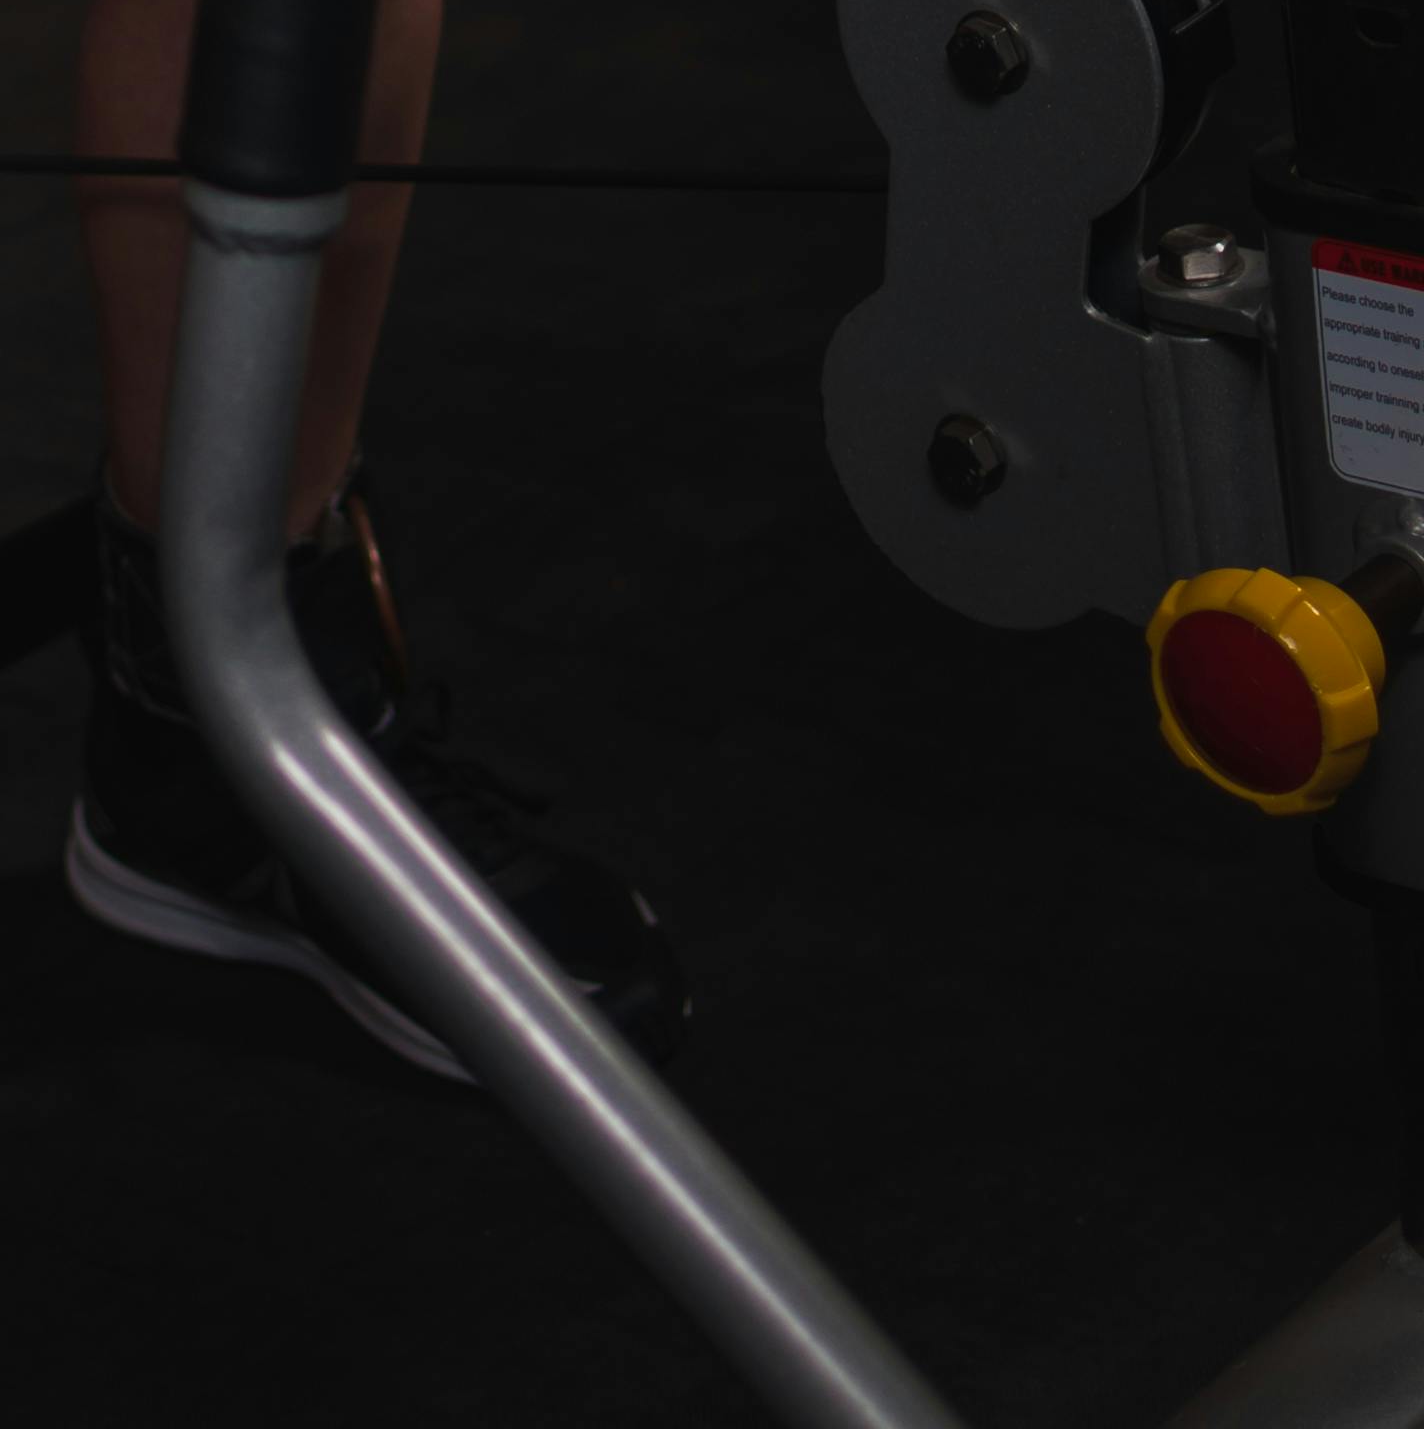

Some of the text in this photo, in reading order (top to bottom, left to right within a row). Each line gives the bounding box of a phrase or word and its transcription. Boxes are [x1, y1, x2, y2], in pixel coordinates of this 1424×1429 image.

[1322, 286, 1414, 316] Please choose the
[1324, 318, 1381, 338] appropriate
[1383, 329, 1420, 349] training
[1327, 351, 1375, 373] according
[1378, 360, 1388, 373] to
[1376, 391, 1419, 414] trainning
[1332, 414, 1363, 430] create
[1365, 420, 1395, 439] bodily
